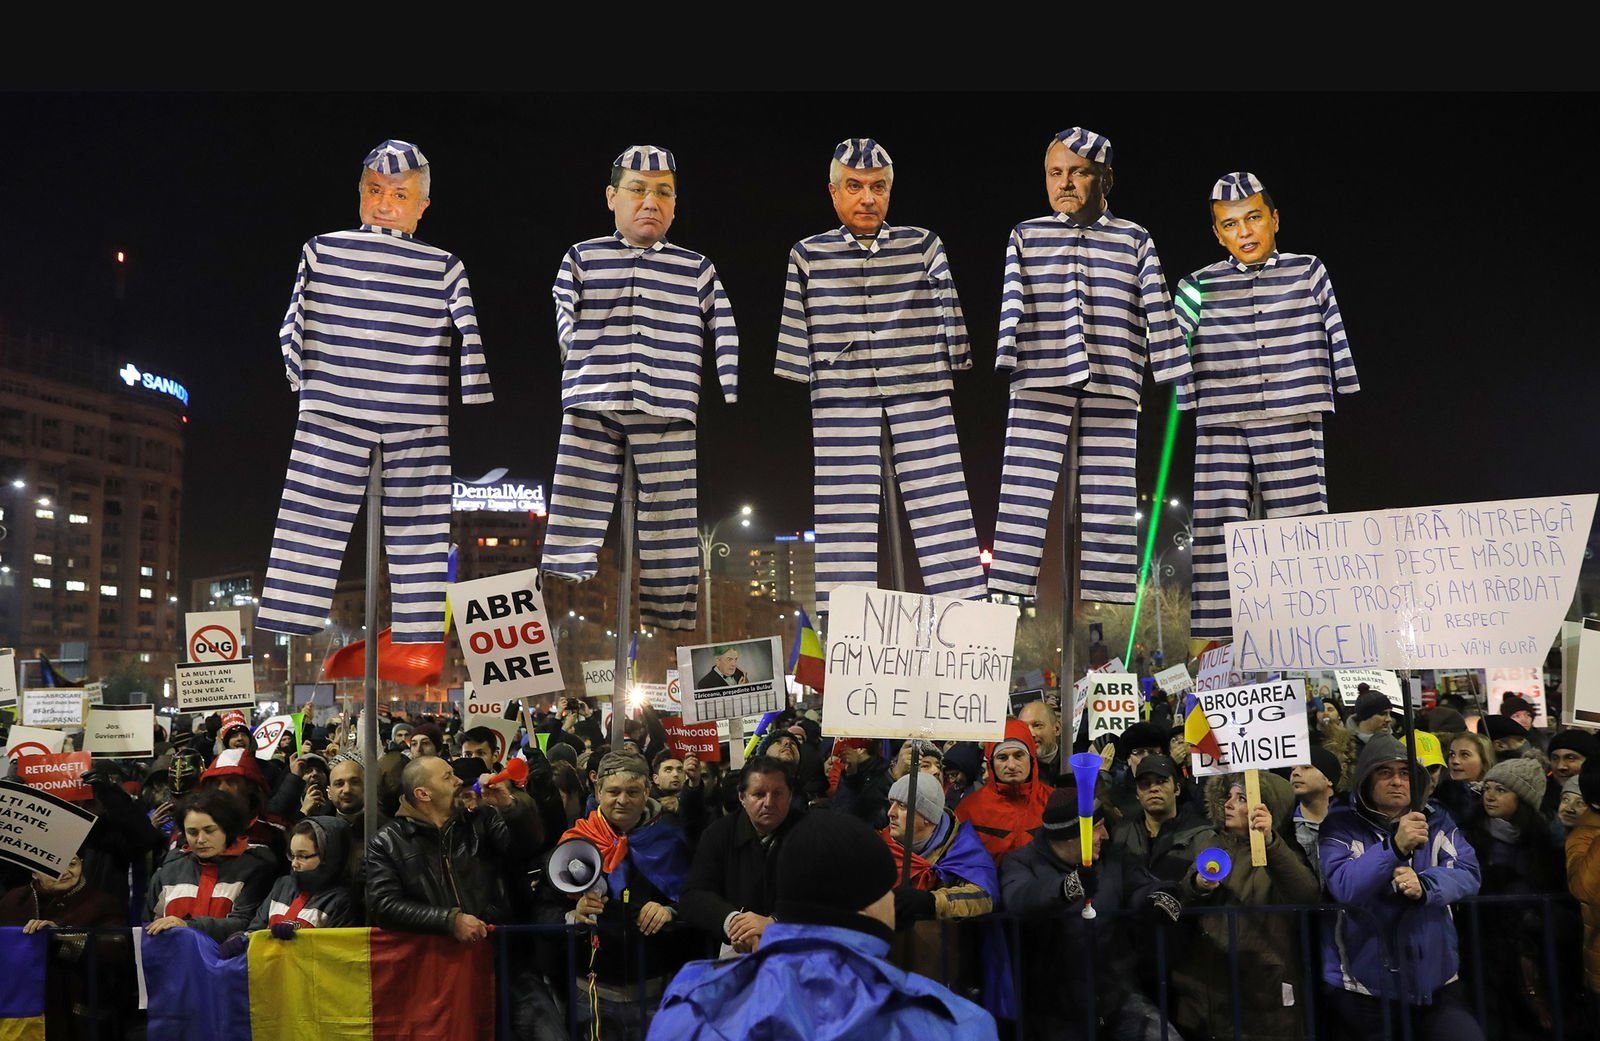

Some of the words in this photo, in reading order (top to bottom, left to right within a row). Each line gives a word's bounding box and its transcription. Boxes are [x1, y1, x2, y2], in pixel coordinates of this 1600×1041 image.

[452, 482, 544, 500] DentalMed
[1363, 517, 1382, 546] O
[1457, 501, 1573, 538] ÎNTREAGĂ
[1308, 553, 1384, 584] FURAT
[1394, 546, 1464, 576] PESTE
[1472, 535, 1566, 571] MĂSURĂ
[466, 589, 538, 624] ABR
[1237, 594, 1273, 623] AM
[1282, 588, 1341, 619] FOST
[1448, 579, 1477, 605] AM
[1483, 574, 1561, 603] RĂBDAT
[1444, 611, 1512, 629] RESPECT
[469, 621, 546, 655] OUG
[1500, 636, 1538, 655] GURĂ
[482, 651, 554, 686] ARE
[829, 641, 863, 676] AM
[868, 647, 930, 676] VENIT
[935, 650, 956, 680] LA
[960, 652, 1014, 682] FURAT
[1093, 683, 1134, 695] ABR
[468, 703, 501, 714] OUG
[846, 682, 878, 717] CĂ
[892, 688, 911, 717] E
[924, 691, 997, 723] LEGAL
[1092, 700, 1136, 713] OUG
[1205, 705, 1286, 730] OUG
[0, 807, 49, 833] ĂTATE,
[25, 802, 52, 817] ANI
